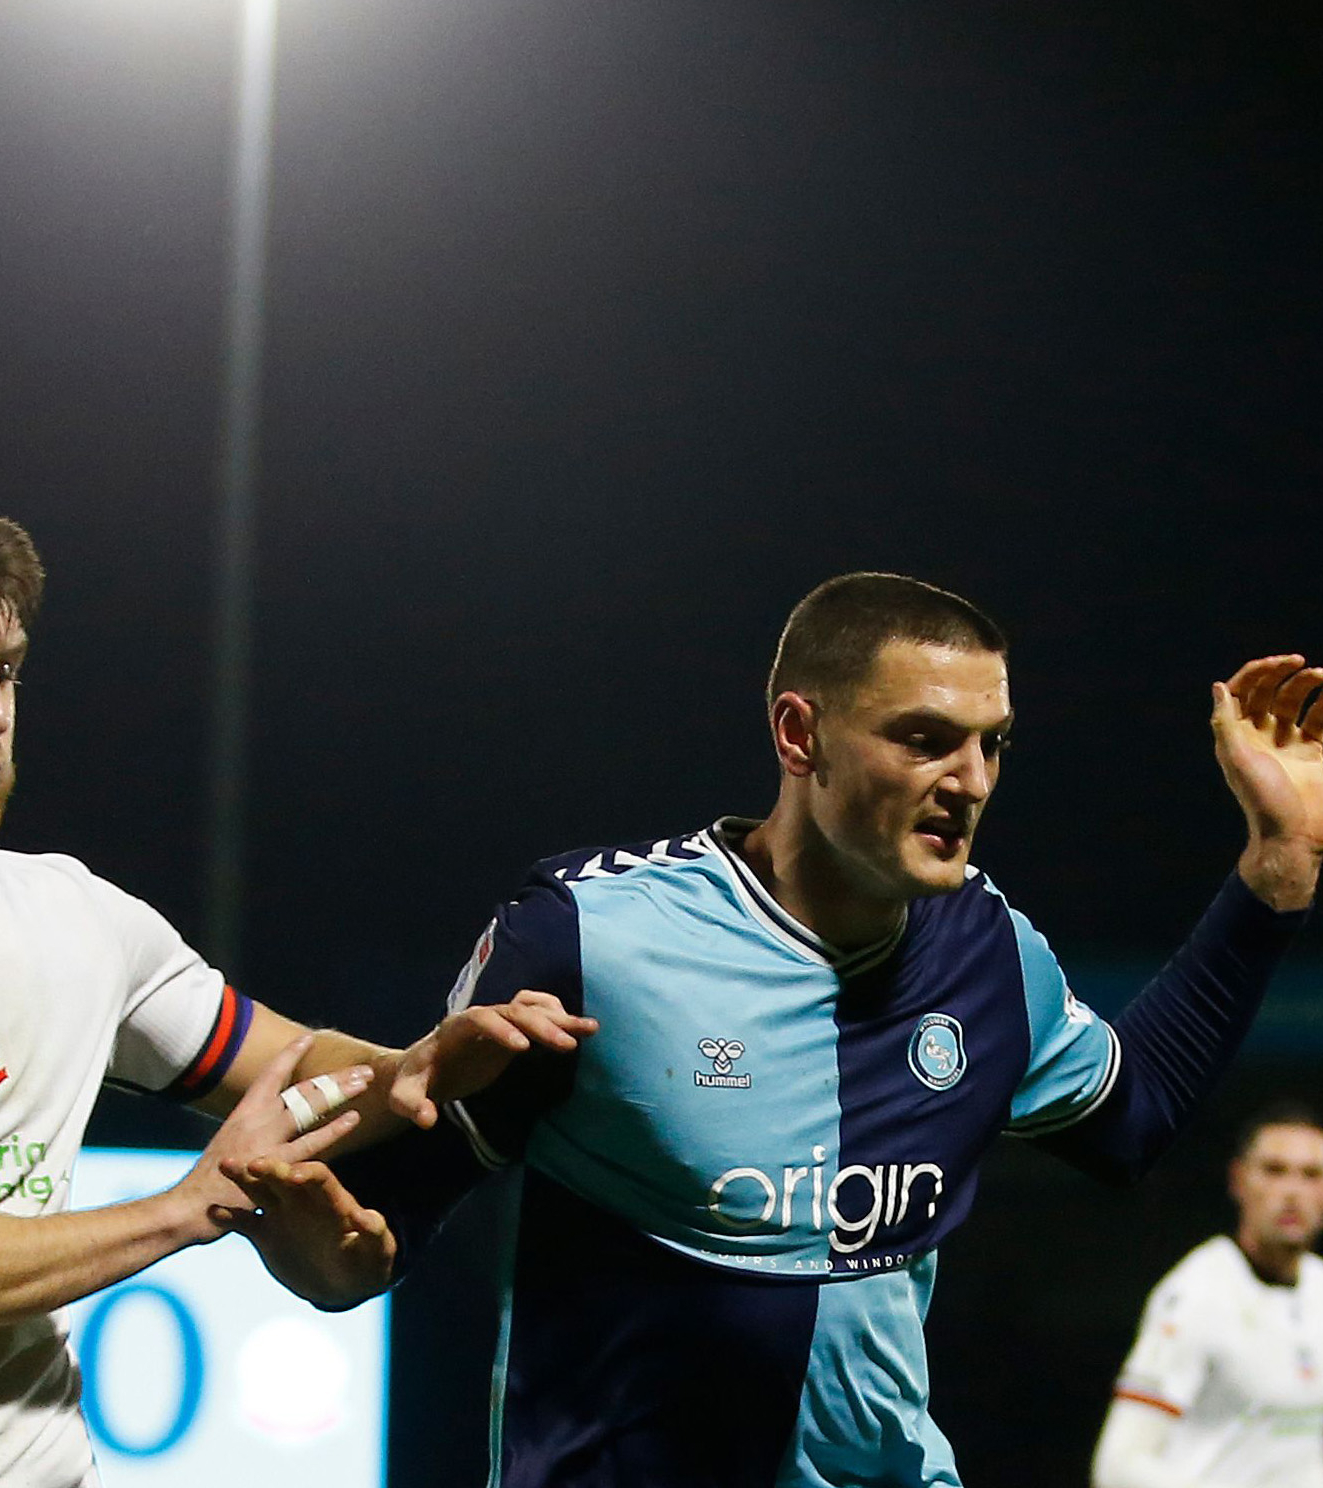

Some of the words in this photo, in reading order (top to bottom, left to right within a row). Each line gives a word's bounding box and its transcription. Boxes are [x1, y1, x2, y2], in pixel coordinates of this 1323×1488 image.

[694, 1070, 752, 1089] hummel
[709, 1145, 944, 1253] origin
[794, 1259, 834, 1271] AND
[80, 1281, 206, 1461] 0
